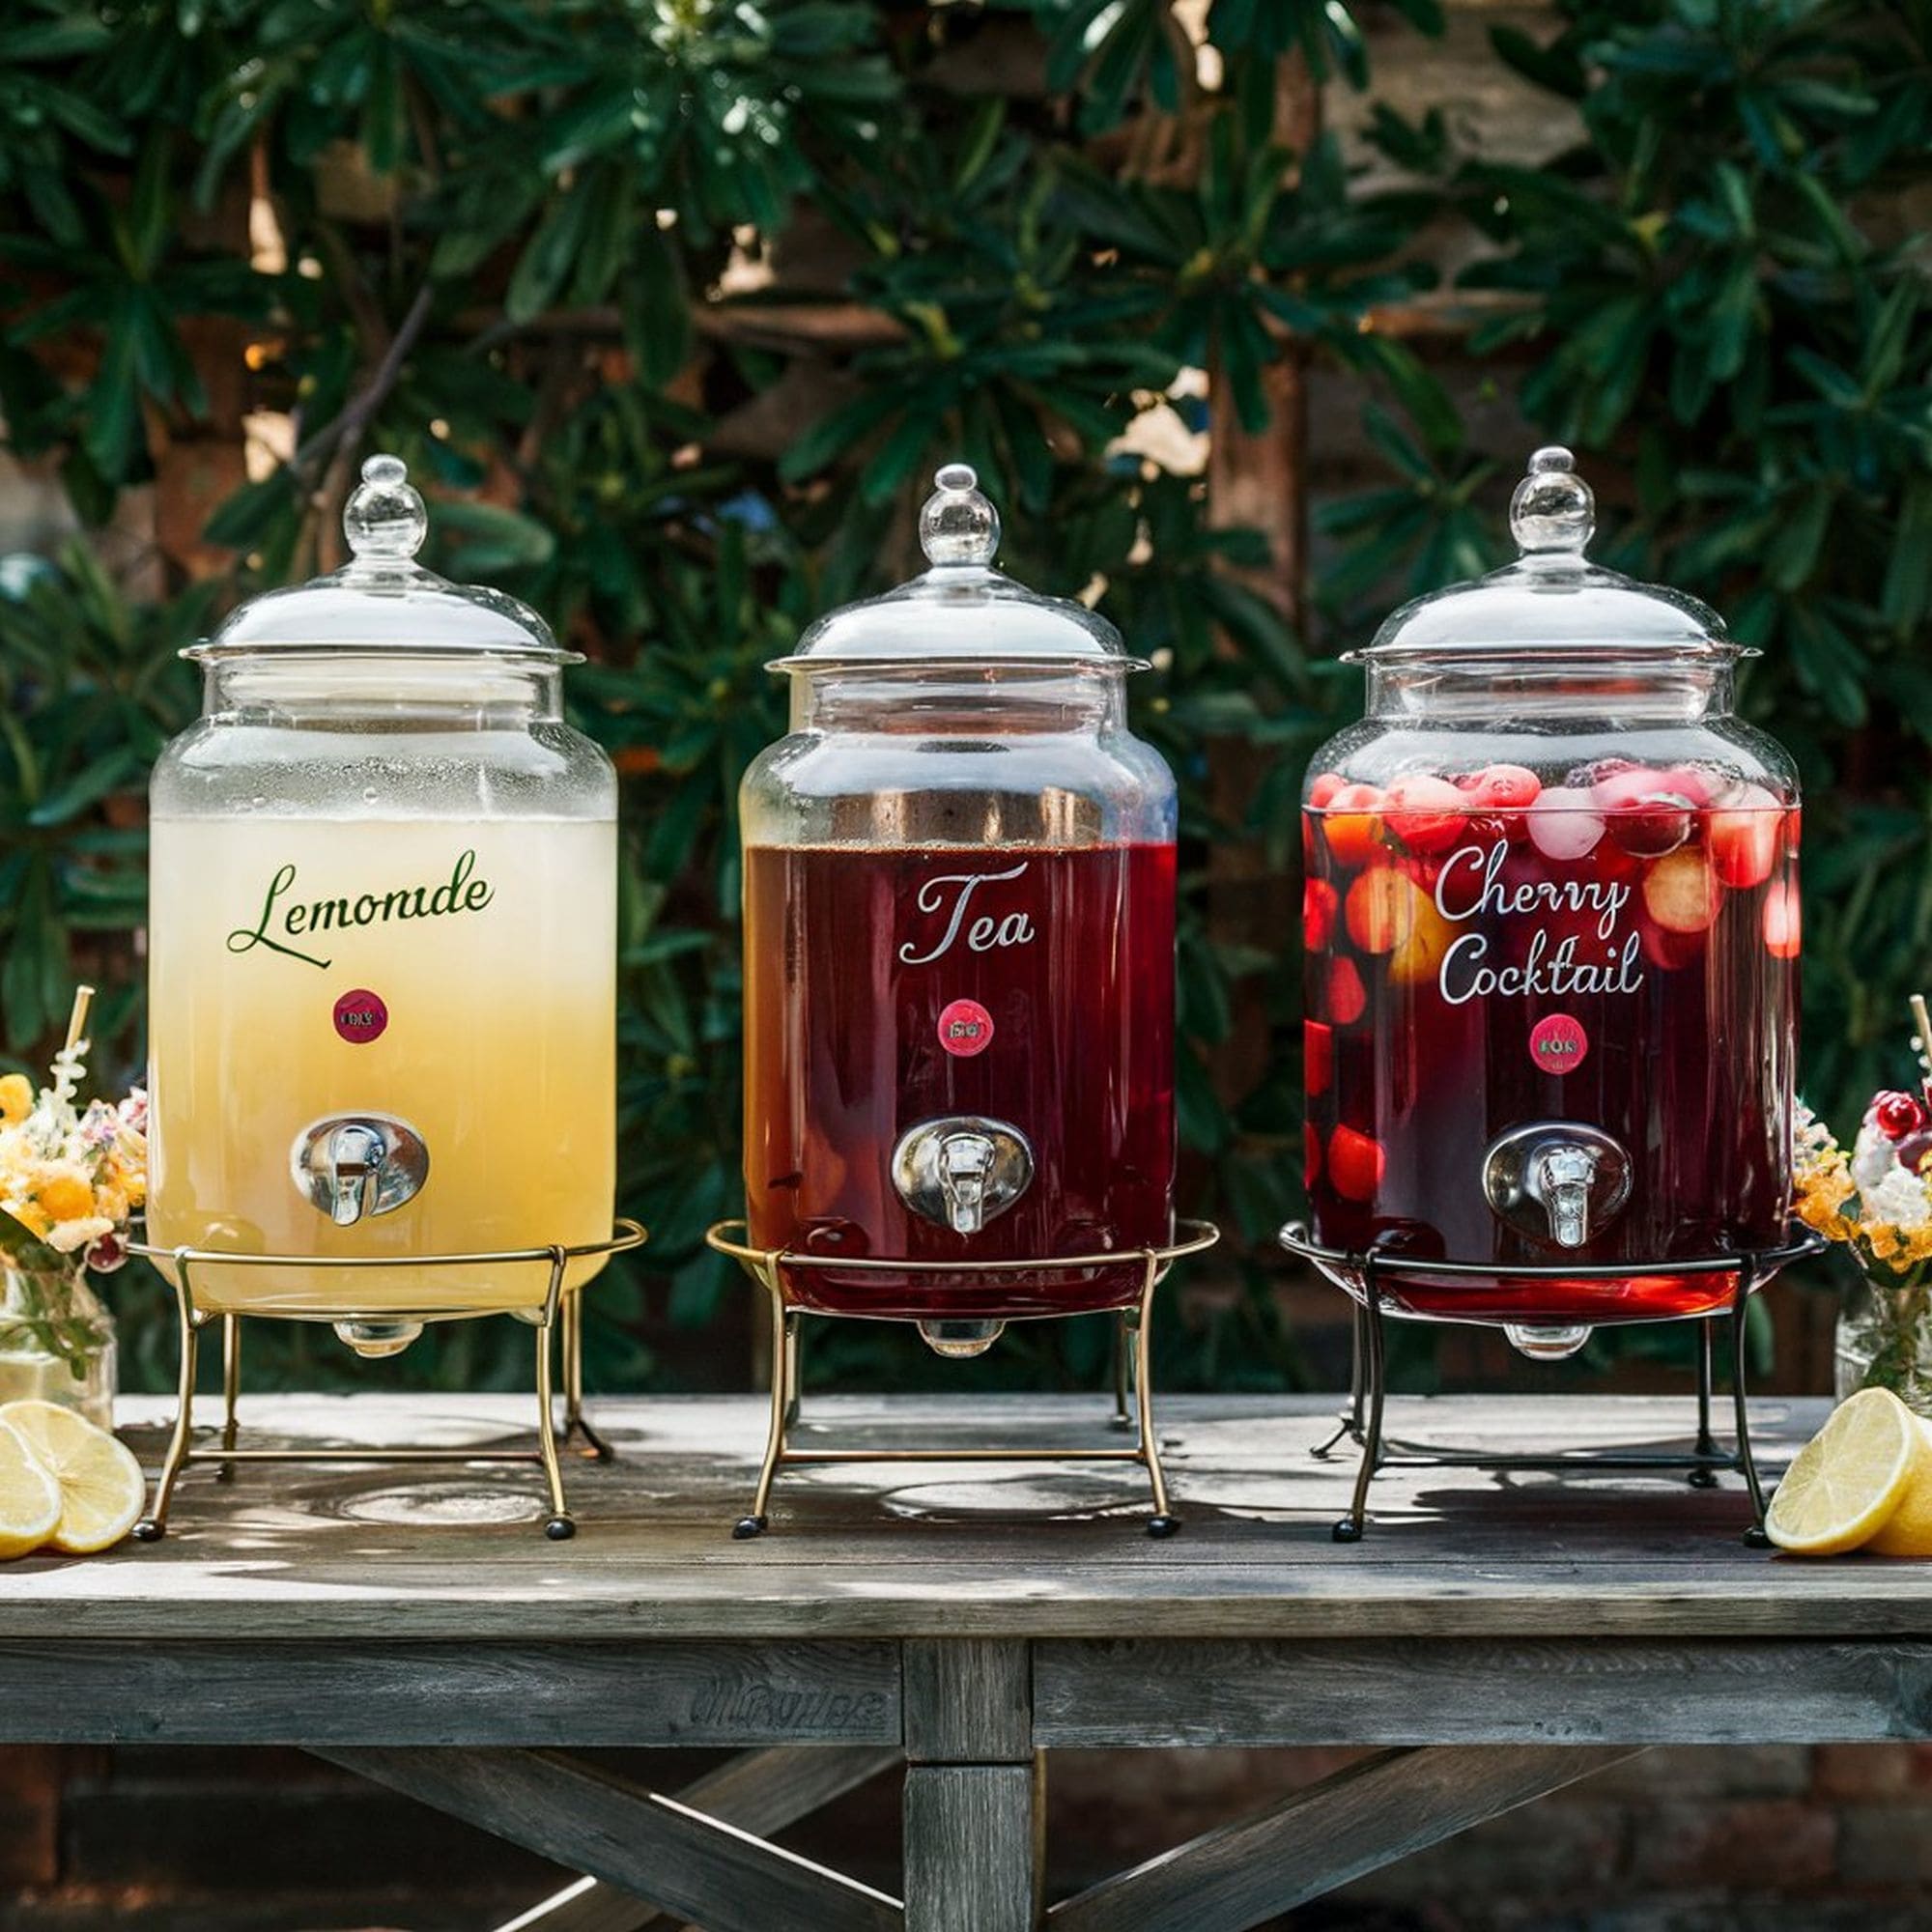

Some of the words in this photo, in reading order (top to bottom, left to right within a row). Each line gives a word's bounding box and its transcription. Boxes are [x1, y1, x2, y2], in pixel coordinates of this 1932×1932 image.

[898, 861, 1036, 964] Tea
[1435, 838, 1632, 941] Cherry
[1439, 928, 1644, 1005] Cocktail
